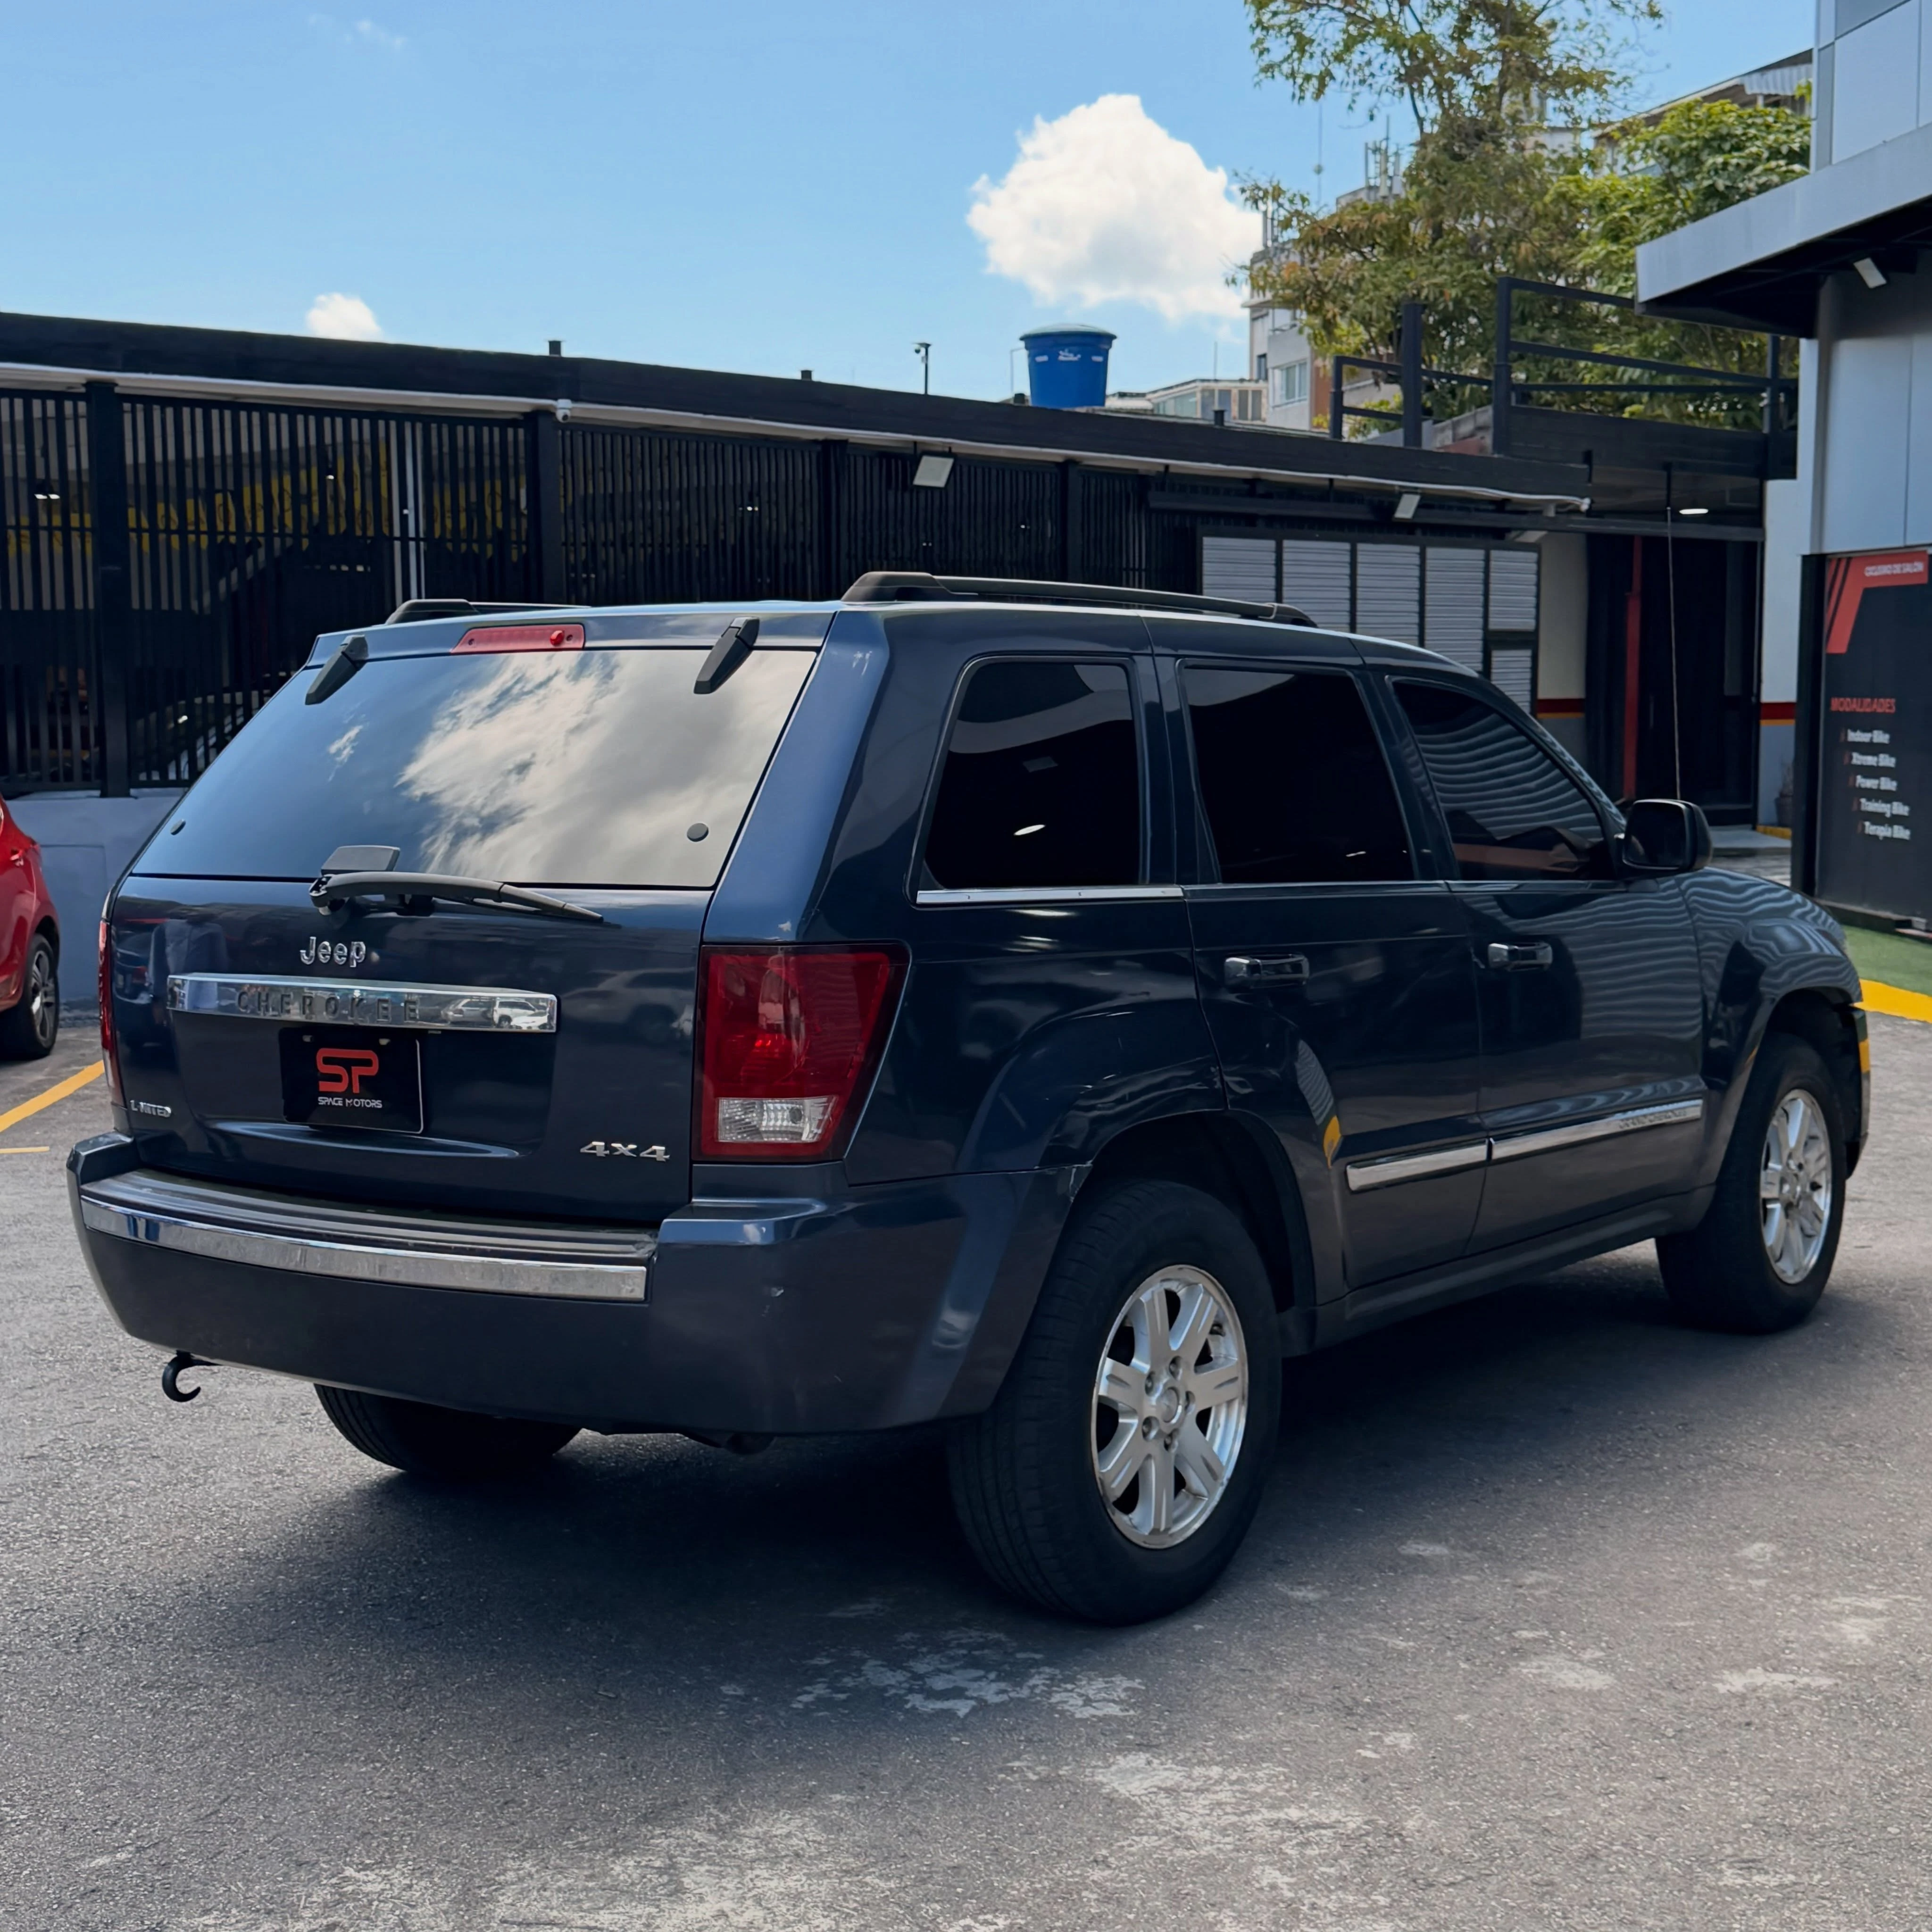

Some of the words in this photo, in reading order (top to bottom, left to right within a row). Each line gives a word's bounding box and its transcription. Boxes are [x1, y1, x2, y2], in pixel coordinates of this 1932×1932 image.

[1831, 698, 1896, 714] MODALIDADES
[1872, 730, 1890, 744] Bike
[1878, 754, 1896, 767] Bike
[1879, 777, 1897, 791] Bike
[1859, 798, 1891, 818] Training
[1891, 801, 1910, 816] Bike
[1864, 821, 1892, 840] Terapia
[1892, 824, 1910, 840] Bike
[300, 936, 366, 967] Jeep
[237, 990, 420, 1023] CHEROKEE
[316, 1048, 379, 1093] SP
[317, 1096, 343, 1106] SPACE
